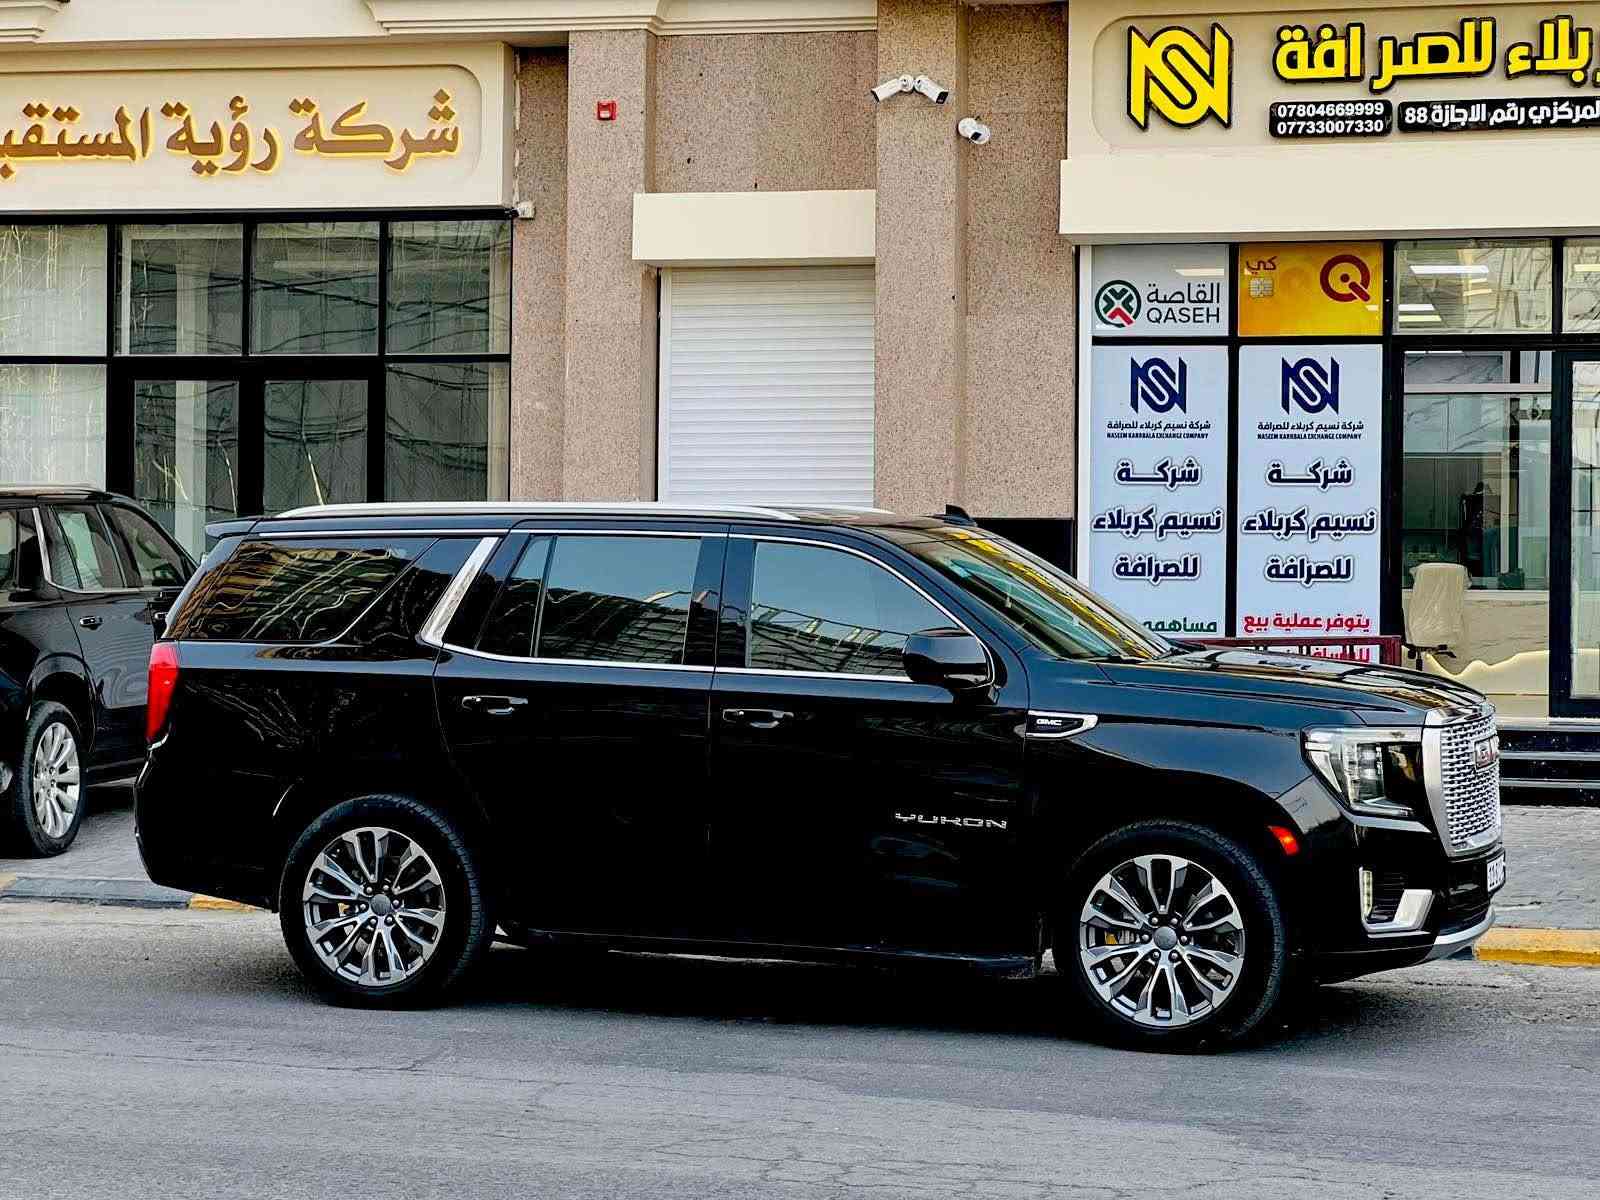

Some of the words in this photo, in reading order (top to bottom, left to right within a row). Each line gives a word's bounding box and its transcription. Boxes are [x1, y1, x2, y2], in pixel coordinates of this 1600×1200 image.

[1503, 15, 1600, 88] بلاء
[1277, 102, 1385, 118] 07804669999
[1404, 106, 1428, 124] 88
[1489, 102, 1525, 126] رقم
[159, 95, 279, 176] رؤية
[287, 88, 461, 171] شركة
[1276, 118, 1384, 135] 07733007330
[1146, 281, 1221, 305] القاصة
[1146, 306, 1221, 325] QASEH
[1107, 420, 1138, 431] للصرافة
[1140, 420, 1162, 431] كربلاء
[1164, 420, 1187, 431] نسيم
[1189, 420, 1211, 431] شركة
[1257, 421, 1289, 432] للصرافة
[1291, 421, 1314, 432] كربلاء
[1316, 421, 1339, 432] نسيم
[1341, 421, 1364, 432] شركة
[1117, 459, 1200, 488] شركة
[1268, 459, 1352, 489] شركة
[1093, 507, 1154, 536] كربلاء
[1158, 509, 1222, 538] نسيم
[1243, 507, 1306, 538] كربلاء
[1310, 511, 1376, 539] نسيم
[1115, 554, 1199, 583] للصرافة
[1266, 555, 1351, 584] للصرافة
[1243, 615, 1269, 634] بيع
[1273, 613, 1322, 631] عملية
[1325, 614, 1370, 632] يتوفر
[1036, 718, 1063, 726] GMC
[895, 812, 1008, 829] YUKON
